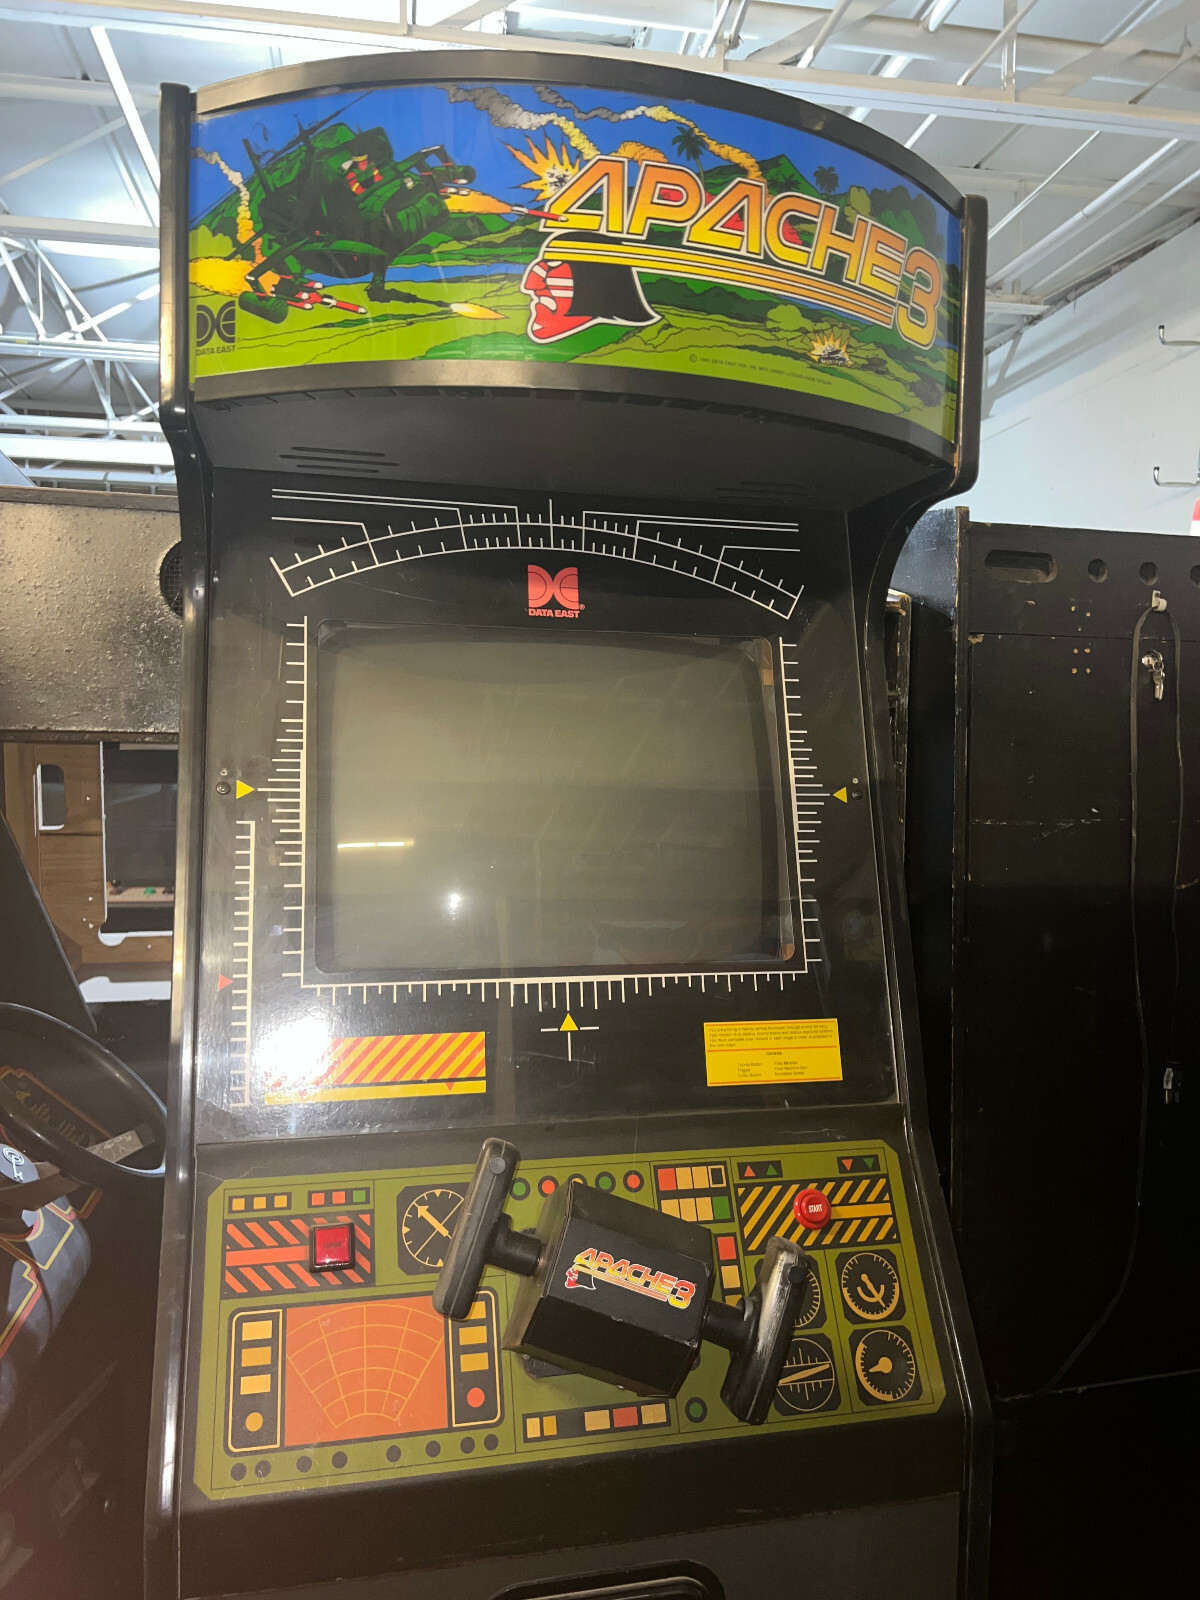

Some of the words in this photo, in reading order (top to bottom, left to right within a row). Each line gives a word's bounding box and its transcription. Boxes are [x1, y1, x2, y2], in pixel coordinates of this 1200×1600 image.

[540, 155, 909, 300] APACHE
[894, 246, 944, 351] 3
[195, 348, 215, 356] DATA
[216, 345, 237, 354] EAST
[528, 608, 554, 618] DATA
[554, 609, 580, 619] EAST
[808, 1203, 823, 1213] START
[573, 1247, 678, 1295] APACHE
[667, 1279, 696, 1310] 3
